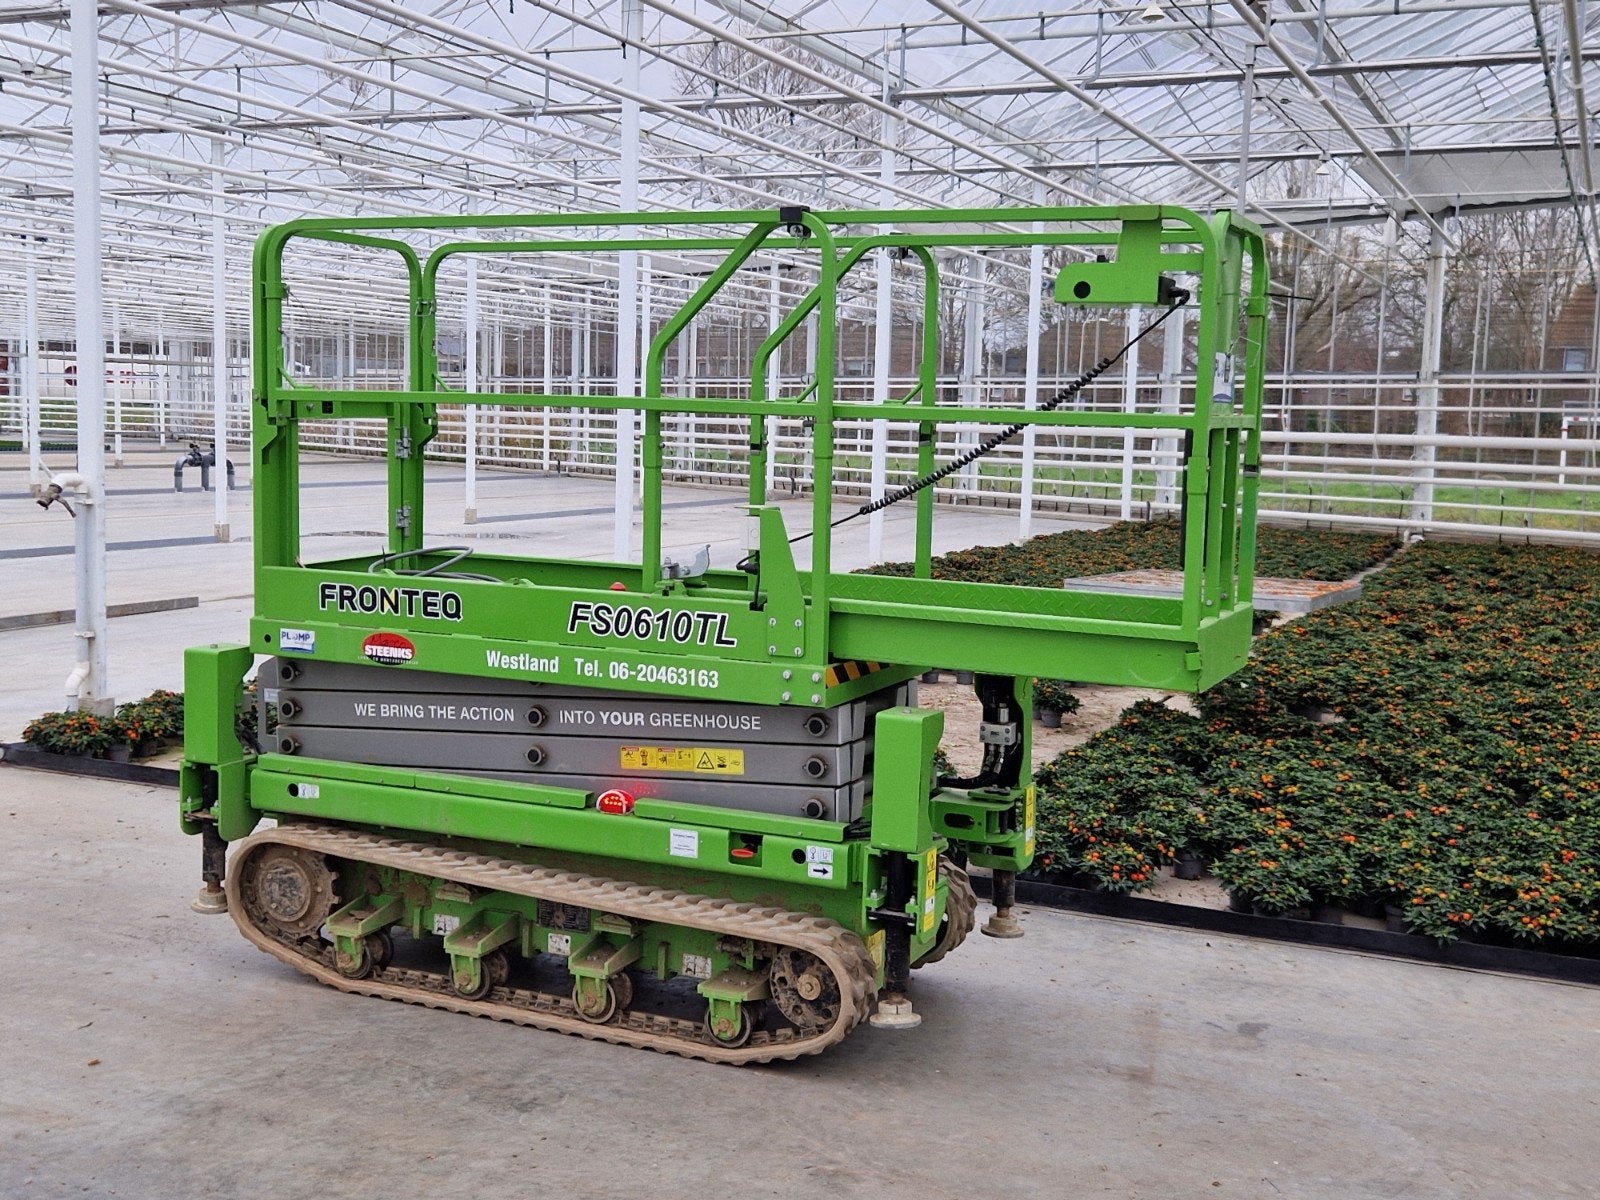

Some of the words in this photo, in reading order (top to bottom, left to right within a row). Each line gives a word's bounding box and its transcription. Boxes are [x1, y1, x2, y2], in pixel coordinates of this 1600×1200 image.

[319, 582, 462, 622] FRONTEQ
[568, 601, 738, 648] FS0610TL
[486, 650, 559, 674] Westland
[574, 658, 603, 678] Tel.
[609, 661, 719, 689] 06-20463163
[354, 703, 376, 717] WE
[380, 704, 424, 718] BRING
[428, 705, 456, 720] THE
[460, 706, 515, 722] ACTION
[559, 710, 595, 725] INTO
[600, 711, 645, 726] YOUR
[650, 712, 762, 730] GREENHOUSE
